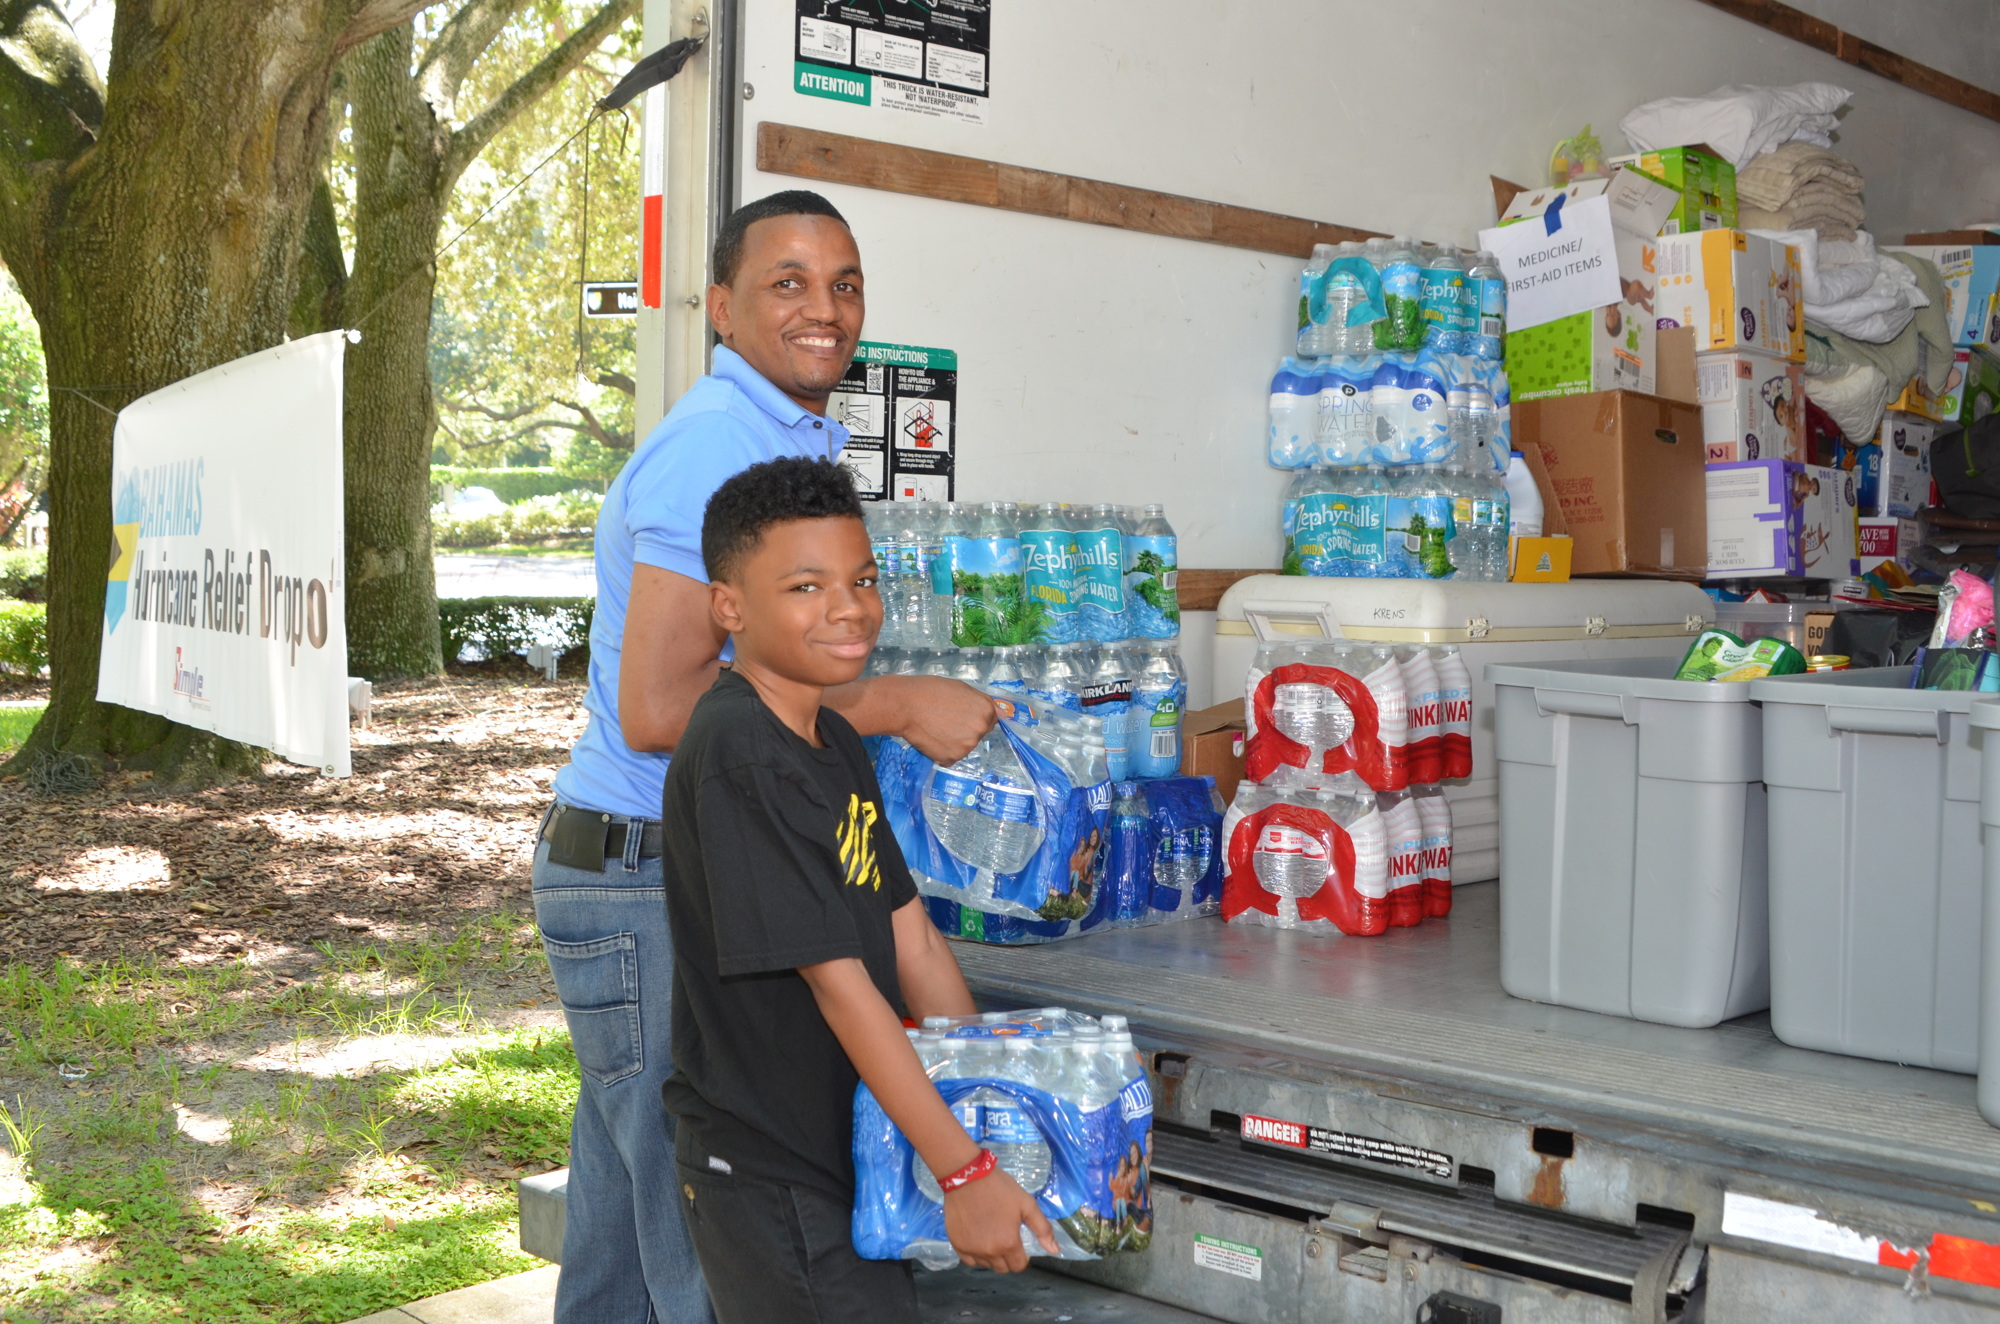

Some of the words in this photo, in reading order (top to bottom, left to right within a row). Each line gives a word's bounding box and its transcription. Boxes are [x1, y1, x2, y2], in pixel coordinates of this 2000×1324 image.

[799, 71, 864, 97] ATTENTION
[883, 79, 897, 90] THIS
[898, 82, 917, 94] TRUCK
[919, 86, 925, 95] IS
[926, 87, 979, 106] WATER-RESISTANT,
[905, 92, 917, 101] NOT
[918, 94, 958, 109] WATERPROOF.
[1518, 237, 1583, 269] MEDICINE/
[1564, 255, 1603, 277] ITEMS
[868, 346, 929, 364] INSTRUCTIONS
[898, 375, 907, 383] THE
[907, 376, 932, 385] APPLIANCE
[916, 369, 926, 377] USE
[898, 383, 914, 391] UTILITY
[1519, 388, 1562, 400] cucumber
[1564, 386, 1588, 396] fresh
[1318, 394, 1374, 415] SPRING
[1709, 448, 1724, 459] 2
[1868, 454, 1879, 470] 18
[138, 455, 204, 539] BAHAMAS
[1295, 502, 1381, 534] Zephyrhills
[1860, 528, 1879, 540] AVE
[1030, 584, 1068, 604] FLORIDA
[1090, 582, 1119, 602] WATER
[132, 549, 198, 628] Hurricane
[202, 548, 253, 636] Relief
[259, 549, 334, 667] Dropo
[1373, 607, 1405, 620] KRENS
[173, 646, 204, 703] Simple
[1156, 702, 1174, 713] 40
[1444, 700, 1472, 723] WAT
[1116, 719, 1145, 734] water
[1423, 845, 1453, 870] WAT
[1245, 1117, 1301, 1144] DANGER
[1365, 1139, 1379, 1150] ramp
[1380, 1141, 1395, 1152] while
[1200, 1235, 1220, 1247] TOWING
[1220, 1239, 1258, 1256] INSTRUCTIONS
